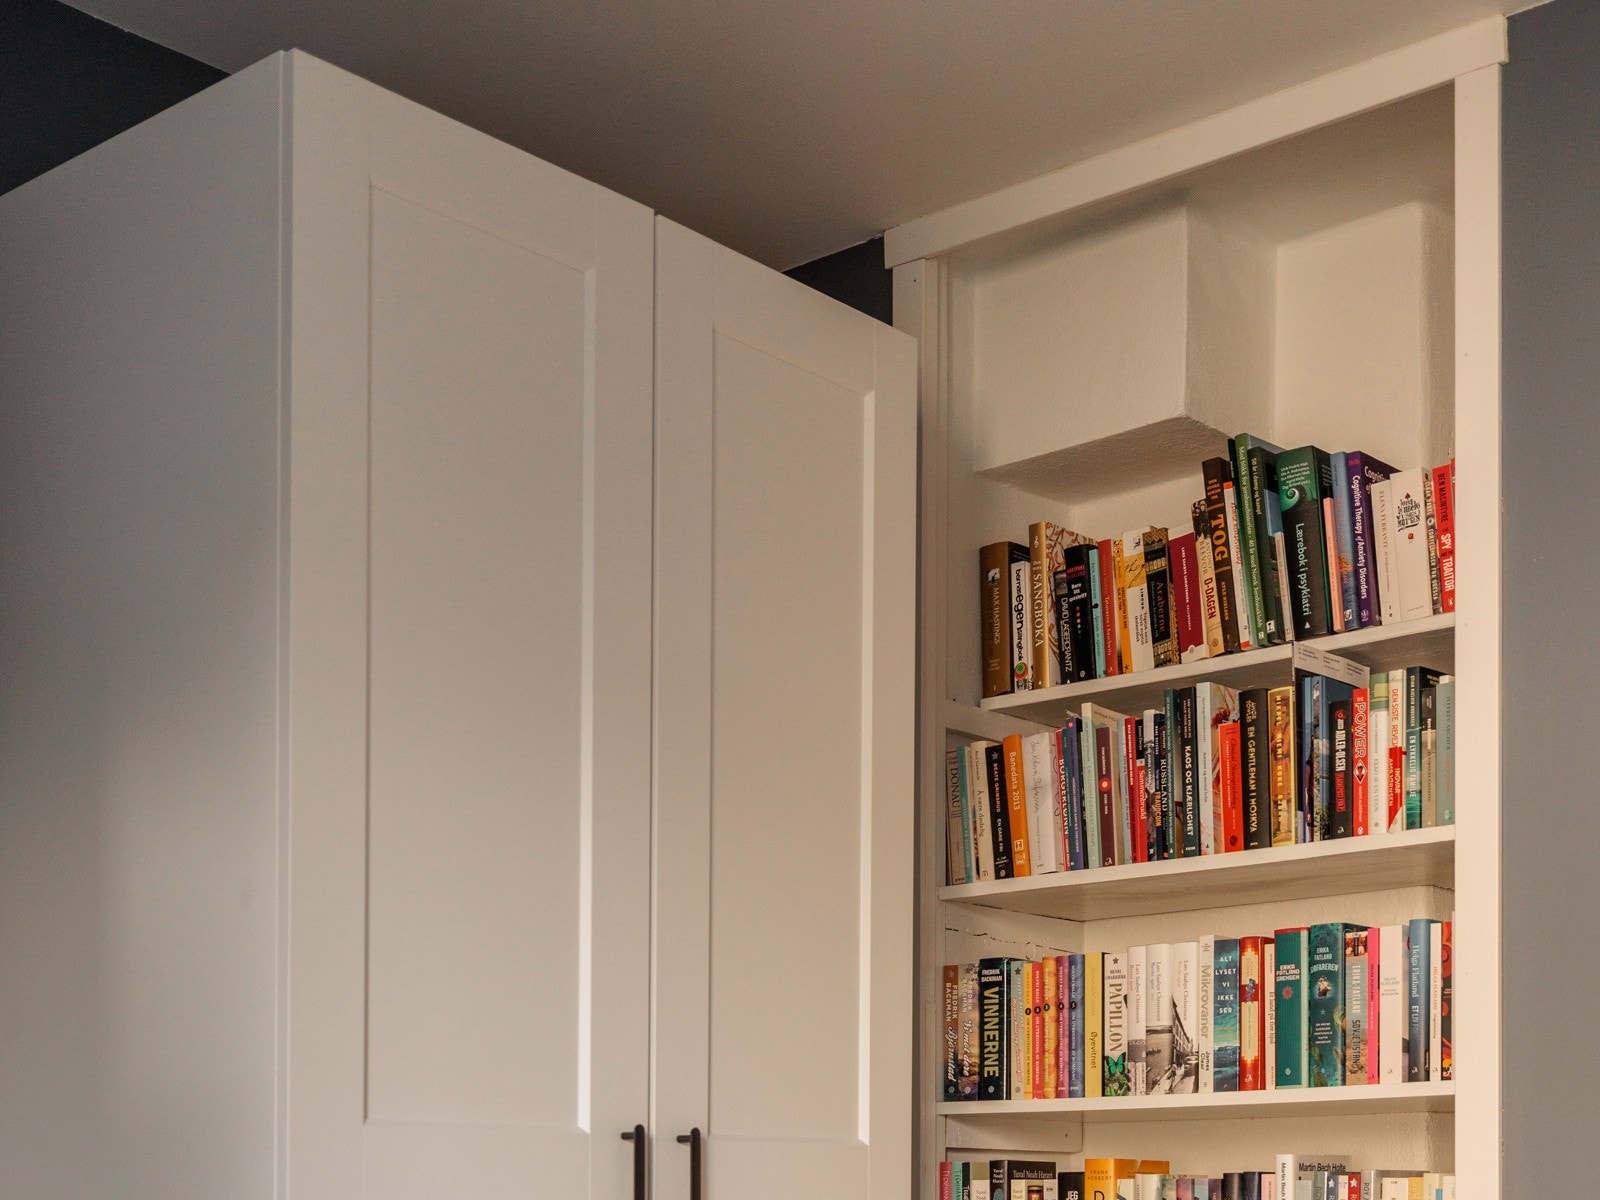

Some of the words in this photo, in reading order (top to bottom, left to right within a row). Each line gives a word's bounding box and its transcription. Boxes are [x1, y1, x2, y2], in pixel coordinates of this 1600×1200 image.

[1351, 475, 1362, 506] Cognitive
[1437, 473, 1446, 486] BEN
[1354, 508, 1364, 534] Therapy
[1438, 487, 1448, 522] MACINTYRE
[1211, 514, 1228, 561] TOG
[1296, 524, 1309, 566] Lærebok
[1356, 542, 1366, 566] Anxiety
[1441, 534, 1452, 549] SPY
[1359, 568, 1368, 599] Disorders
[1443, 557, 1454, 591] TRAITOR
[1033, 574, 1044, 647] SANGBOKA
[1204, 578, 1216, 619] D-DAGEN
[1297, 574, 1312, 615] psykiatri
[1248, 727, 1254, 737] EN
[1355, 703, 1366, 758] POWER
[1336, 731, 1346, 771] ADLER-OLSEN
[950, 768, 962, 808] DONAU
[1010, 752, 1018, 789] Banedata
[1186, 771, 1192, 783] OG
[1411, 946, 1419, 966] Helga
[1109, 983, 1122, 1051] PAPILLON
[1201, 965, 1211, 1039] Mikrovaner
[984, 987, 999, 1077] VINNERNE
[1089, 1032, 1098, 1069] Øyevitnet
[945, 1027, 957, 1081] Bjørnstad
[1065, 1191, 1078, 1200] JEG
